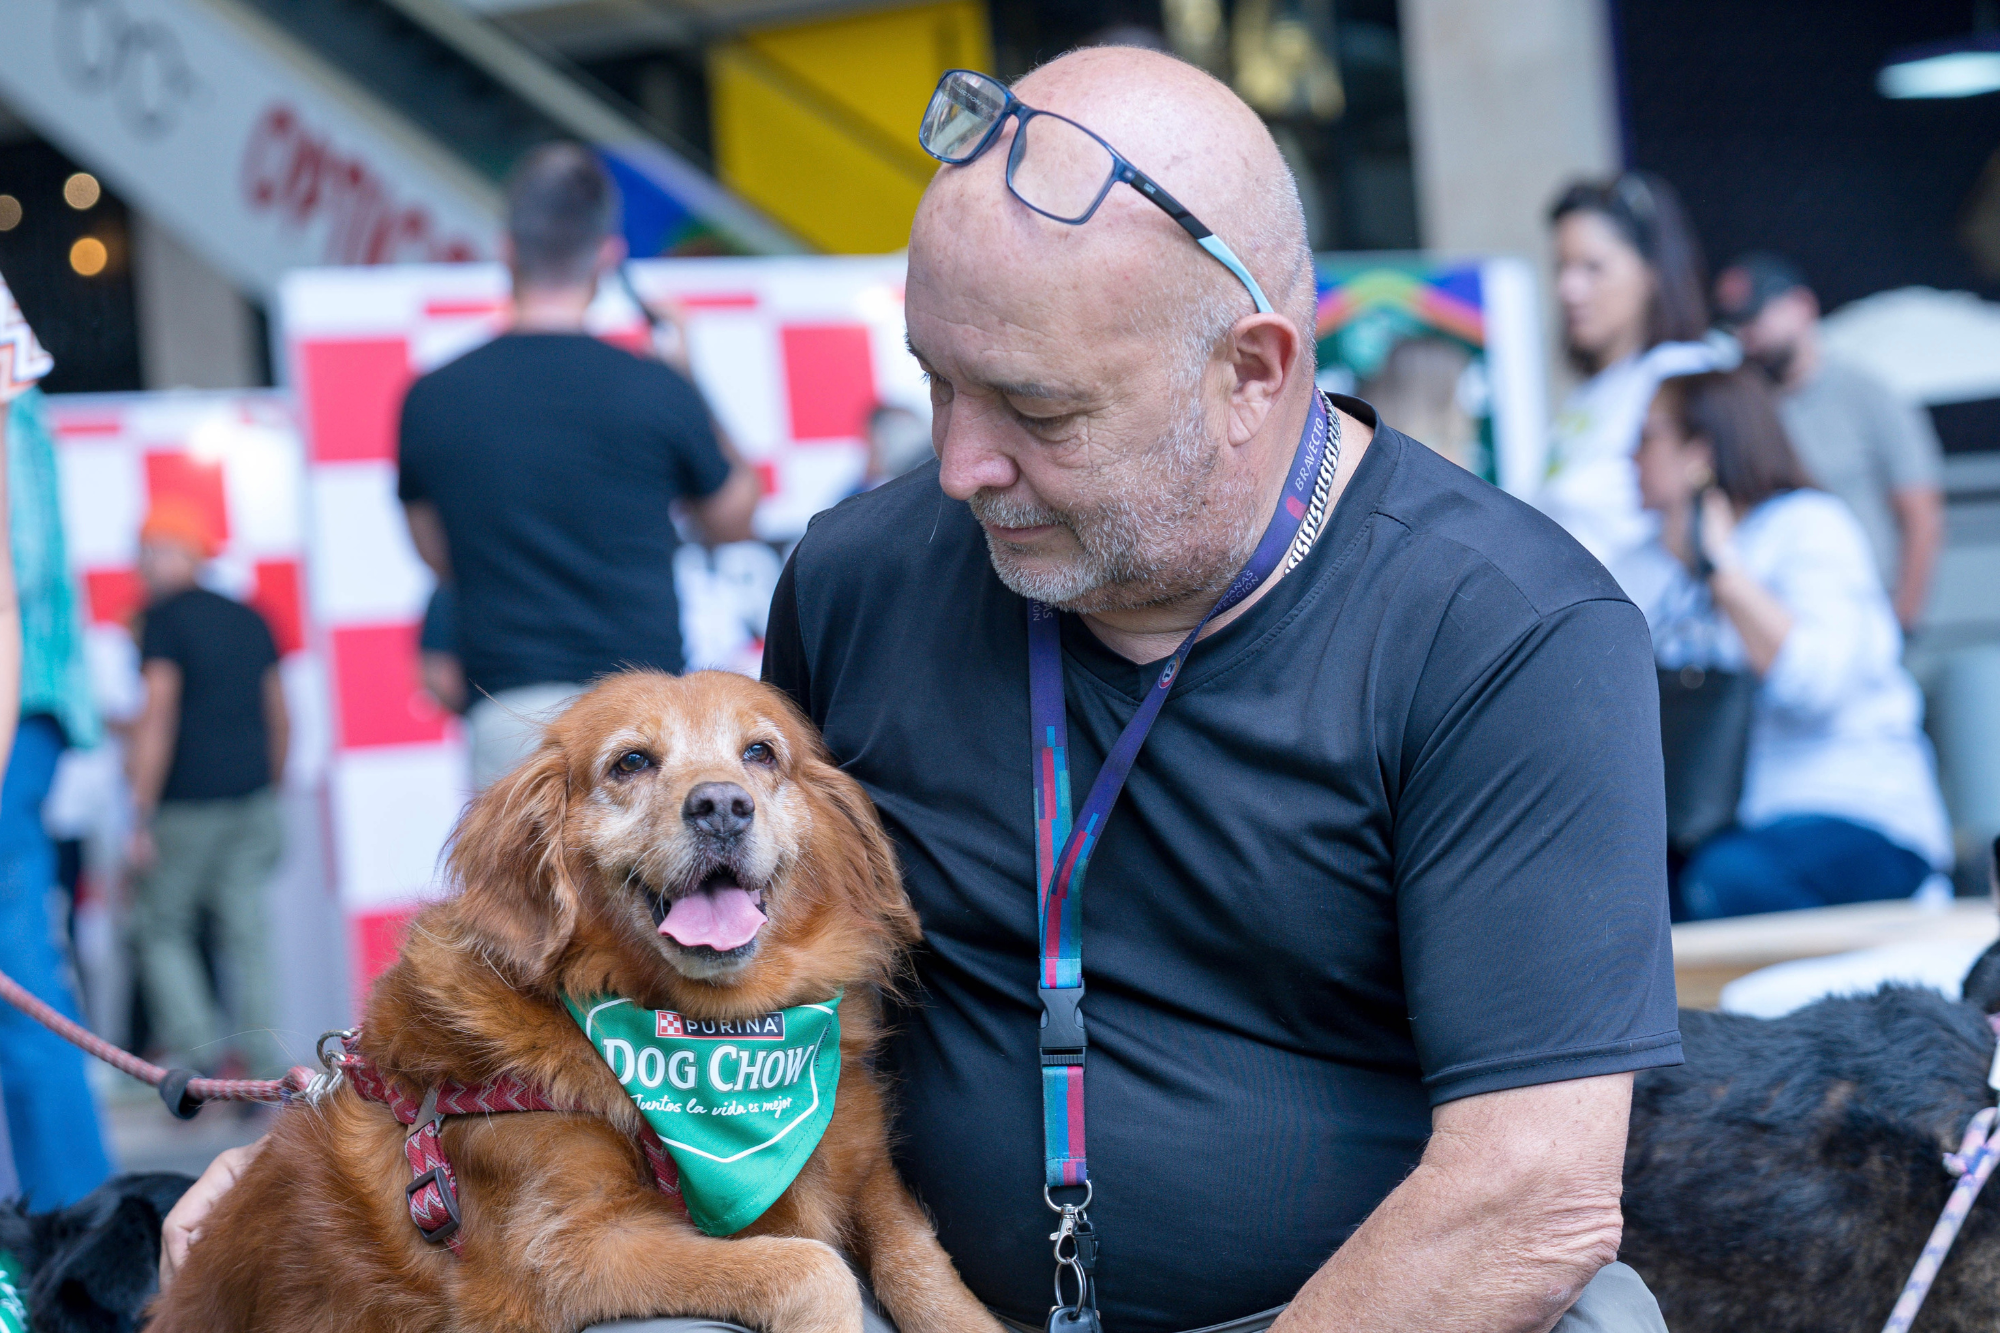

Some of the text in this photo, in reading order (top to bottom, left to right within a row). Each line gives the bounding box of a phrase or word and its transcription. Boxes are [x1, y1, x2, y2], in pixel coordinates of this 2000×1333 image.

[1295, 417, 1324, 492] BRAVECTO
[1163, 662, 1176, 679] 12
[686, 1016, 779, 1035] PURINA
[602, 1037, 698, 1091] DOG
[707, 1044, 815, 1093] CHOW
[630, 1093, 793, 1119] Juntos la vida es mejor
